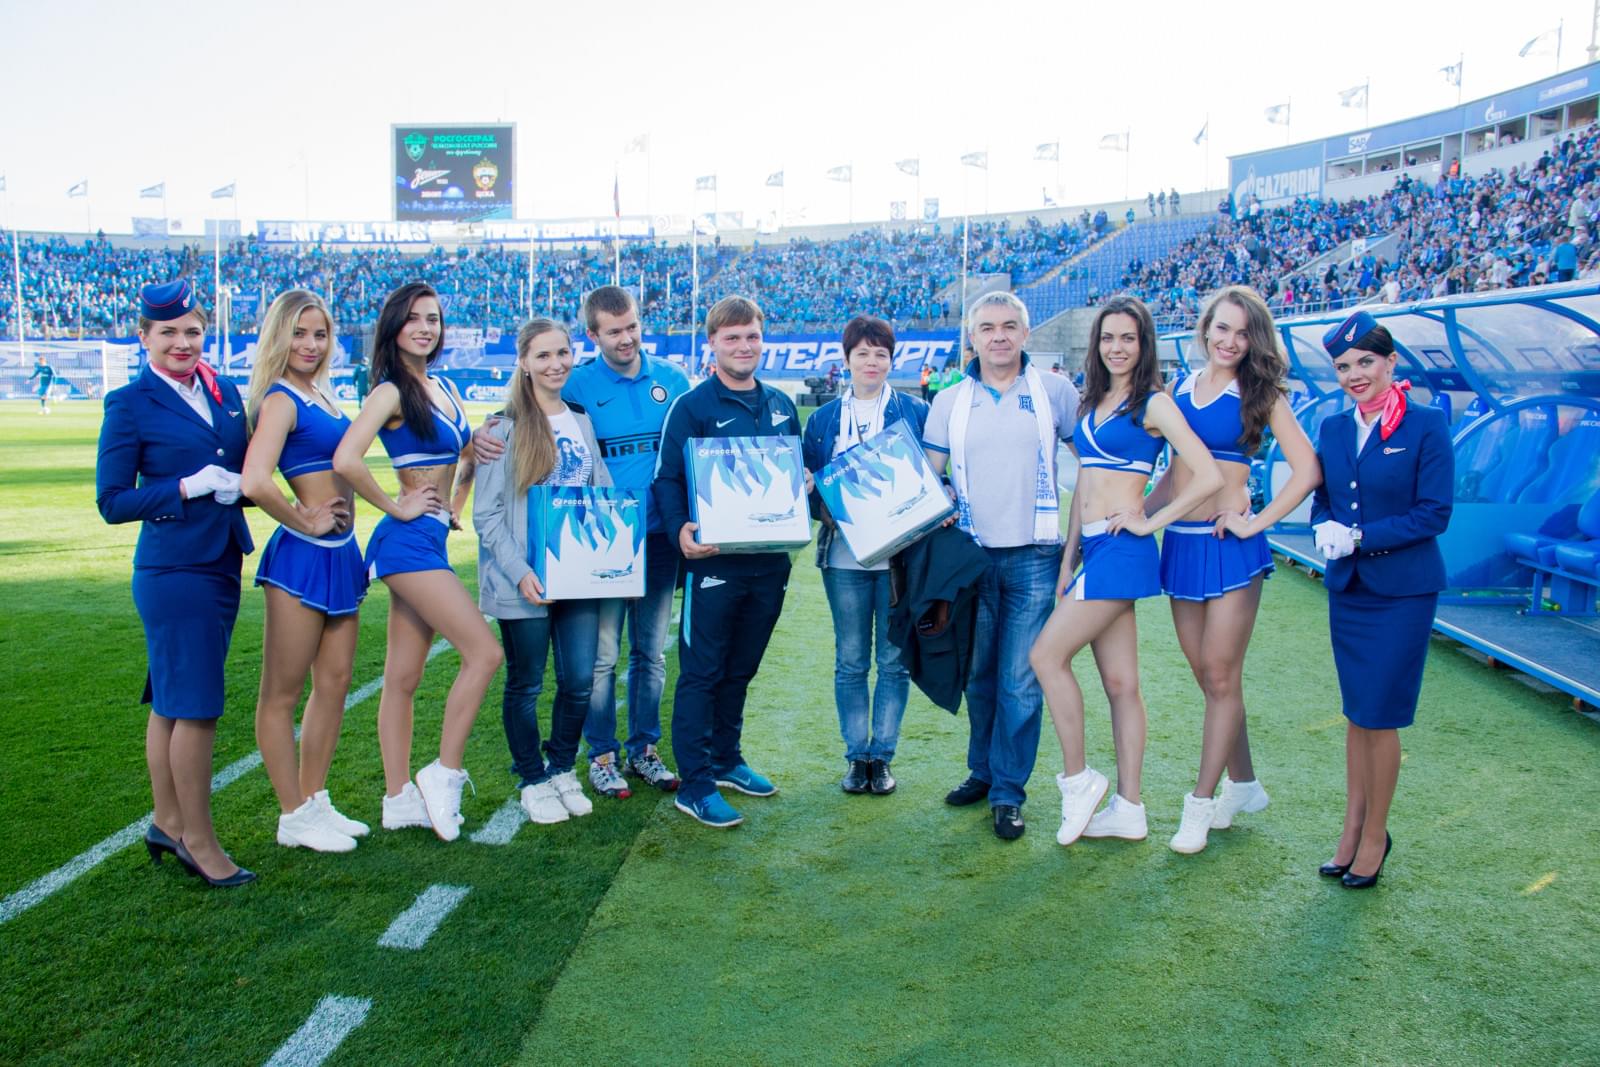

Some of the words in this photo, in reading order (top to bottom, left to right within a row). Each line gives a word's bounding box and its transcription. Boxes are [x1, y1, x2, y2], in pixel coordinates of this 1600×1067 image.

[1255, 166, 1321, 200] GAZPROM
[264, 222, 323, 242] ZENIT
[346, 221, 428, 242] ULTRAS
